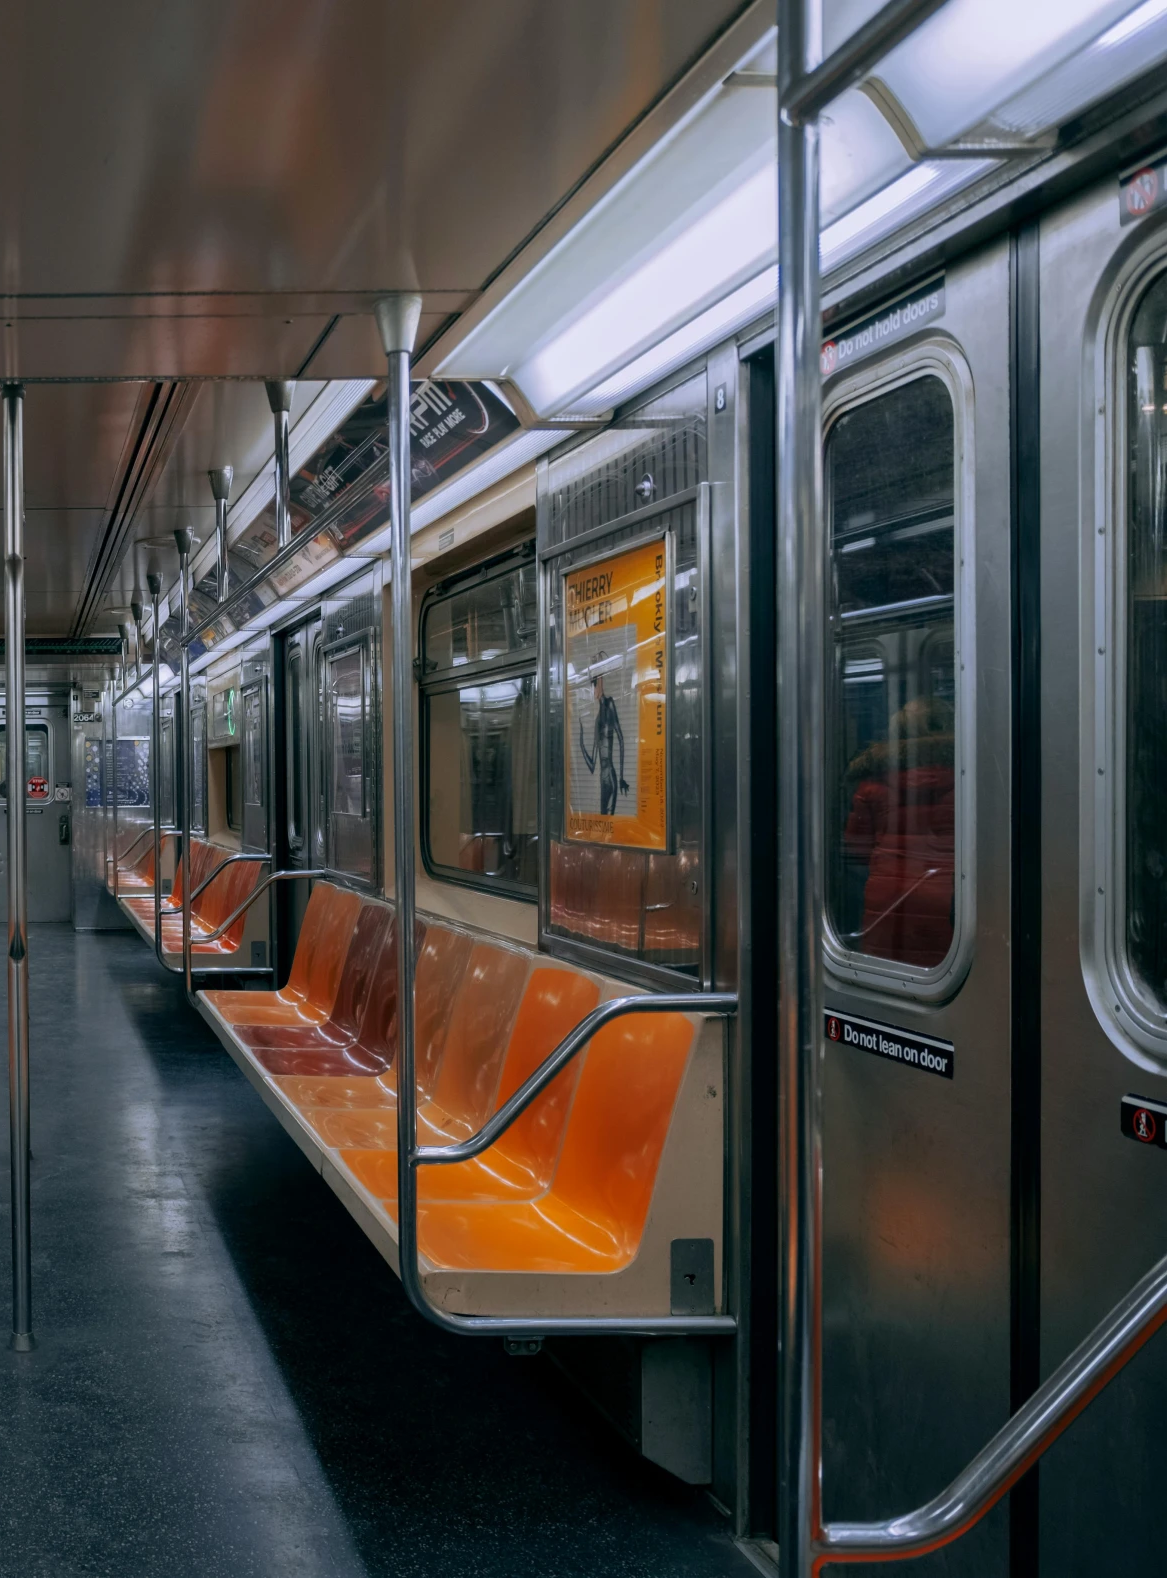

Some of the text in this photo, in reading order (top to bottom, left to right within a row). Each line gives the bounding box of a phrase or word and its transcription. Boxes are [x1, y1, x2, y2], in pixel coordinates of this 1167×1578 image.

[838, 293, 939, 359] Do not hold doors
[716, 388, 725, 410] 8
[419, 408, 466, 449] RACE PLAY MORE
[319, 465, 344, 492] GIFT
[569, 572, 613, 607] THIERRY
[654, 555, 662, 645] Brokly
[844, 1024, 948, 1072] Do not lean on door
